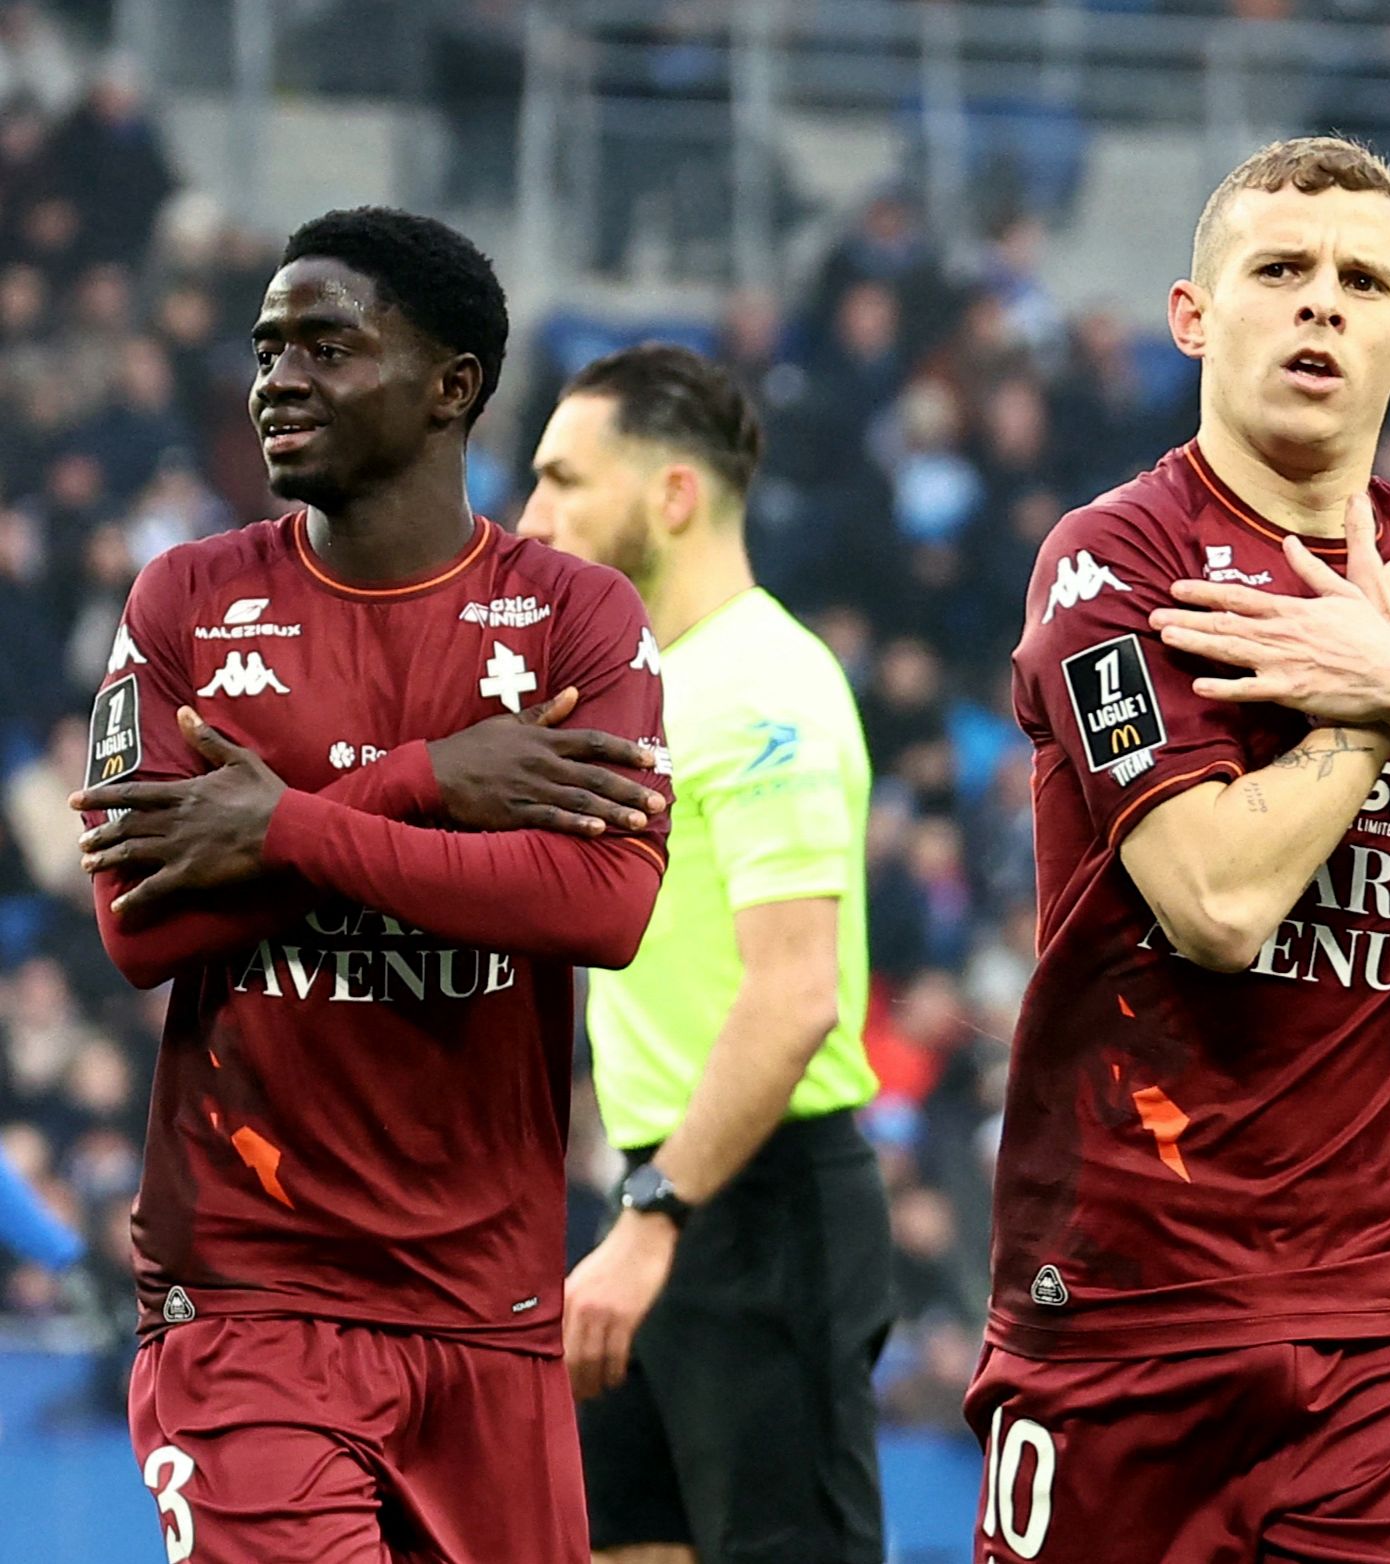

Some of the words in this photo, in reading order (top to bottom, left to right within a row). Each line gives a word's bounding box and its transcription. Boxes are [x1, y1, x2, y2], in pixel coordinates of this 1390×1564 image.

[1088, 696, 1139, 733] LIGUE
[233, 938, 515, 1002] AVENUE
[144, 1445, 195, 1564] 3
[982, 1405, 1056, 1560] 10
